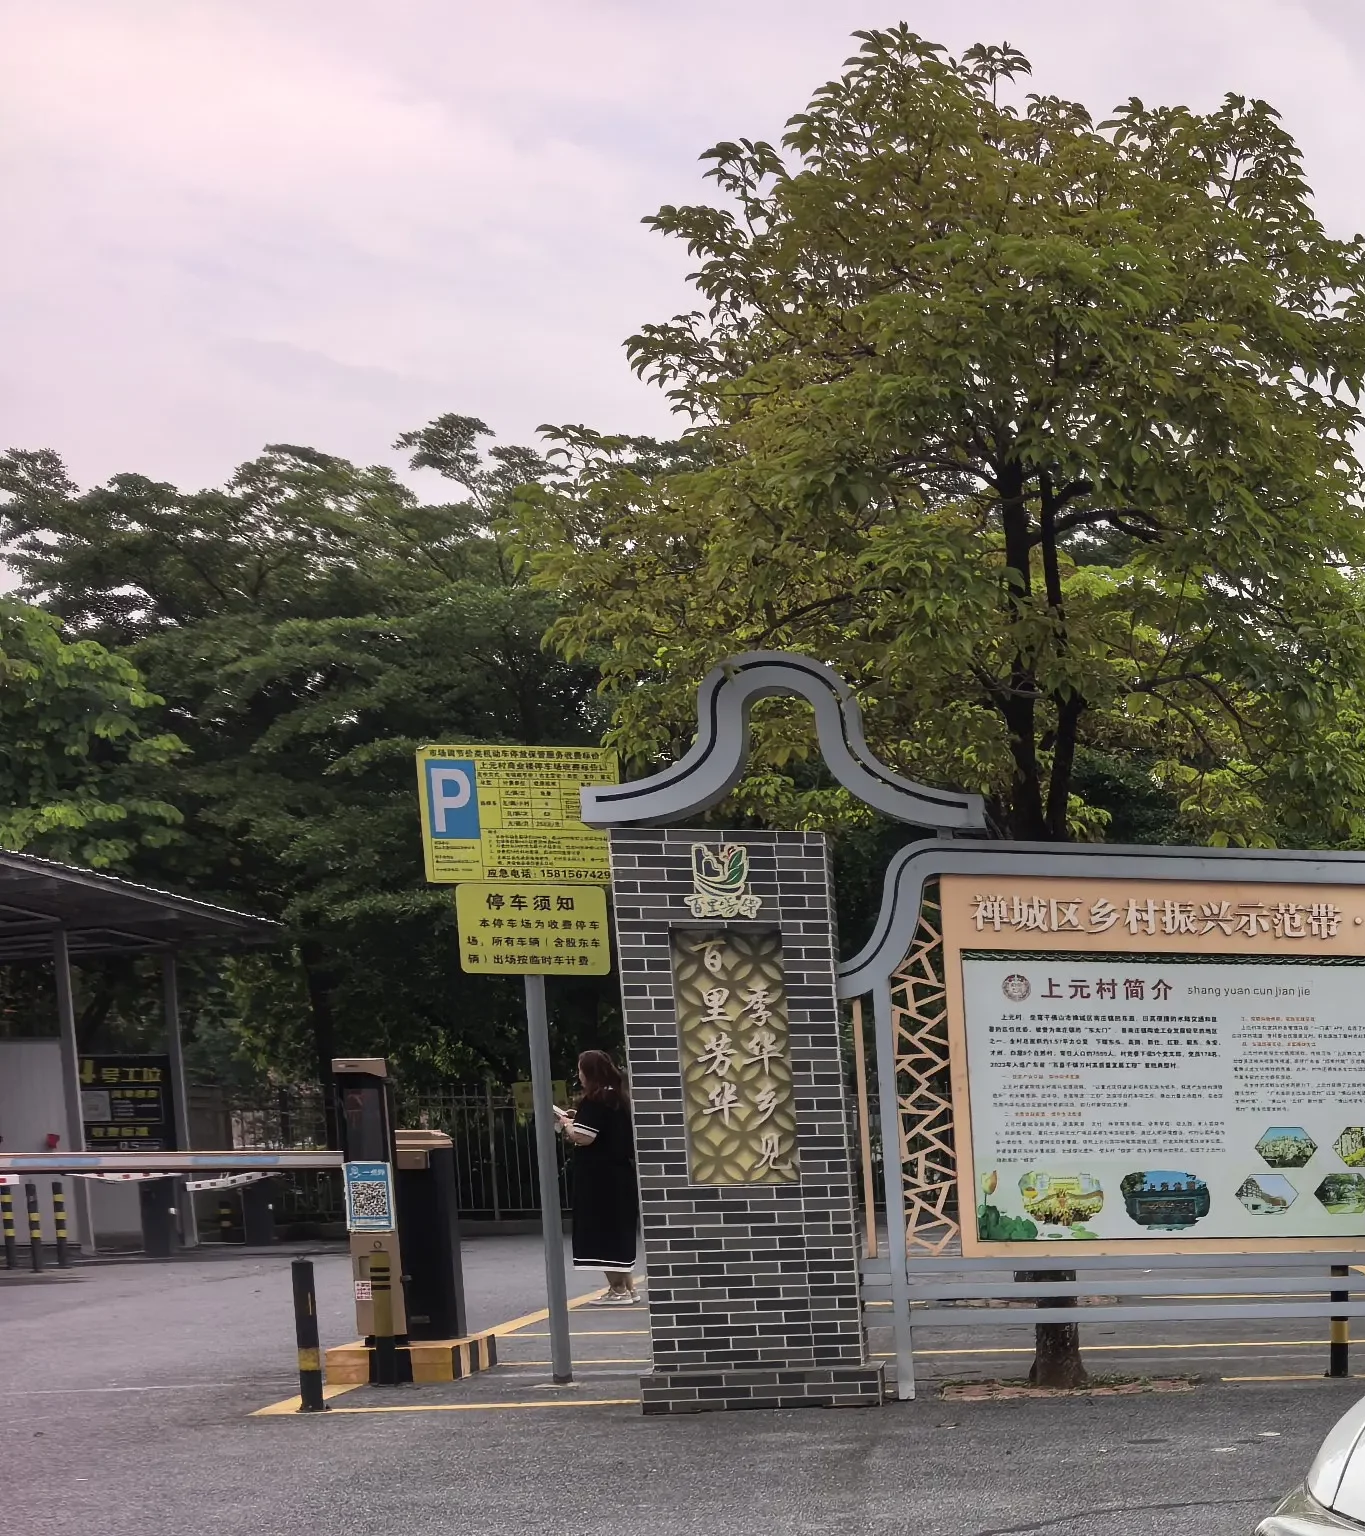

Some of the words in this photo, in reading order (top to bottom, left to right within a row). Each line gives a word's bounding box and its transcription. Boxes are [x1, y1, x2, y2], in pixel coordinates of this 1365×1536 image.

[430, 767, 471, 833] P
[486, 893, 575, 911] 停车须知
[479, 918, 600, 930] 本停车场为收费停车
[1041, 977, 1174, 1002] 上元村简介
[1188, 985, 1221, 997] shang
[1224, 987, 1251, 997] yuan
[1253, 988, 1273, 996] cun
[1274, 986, 1295, 997] jian
[1297, 986, 1311, 998] jie
[689, 939, 745, 1126] 百里芳华
